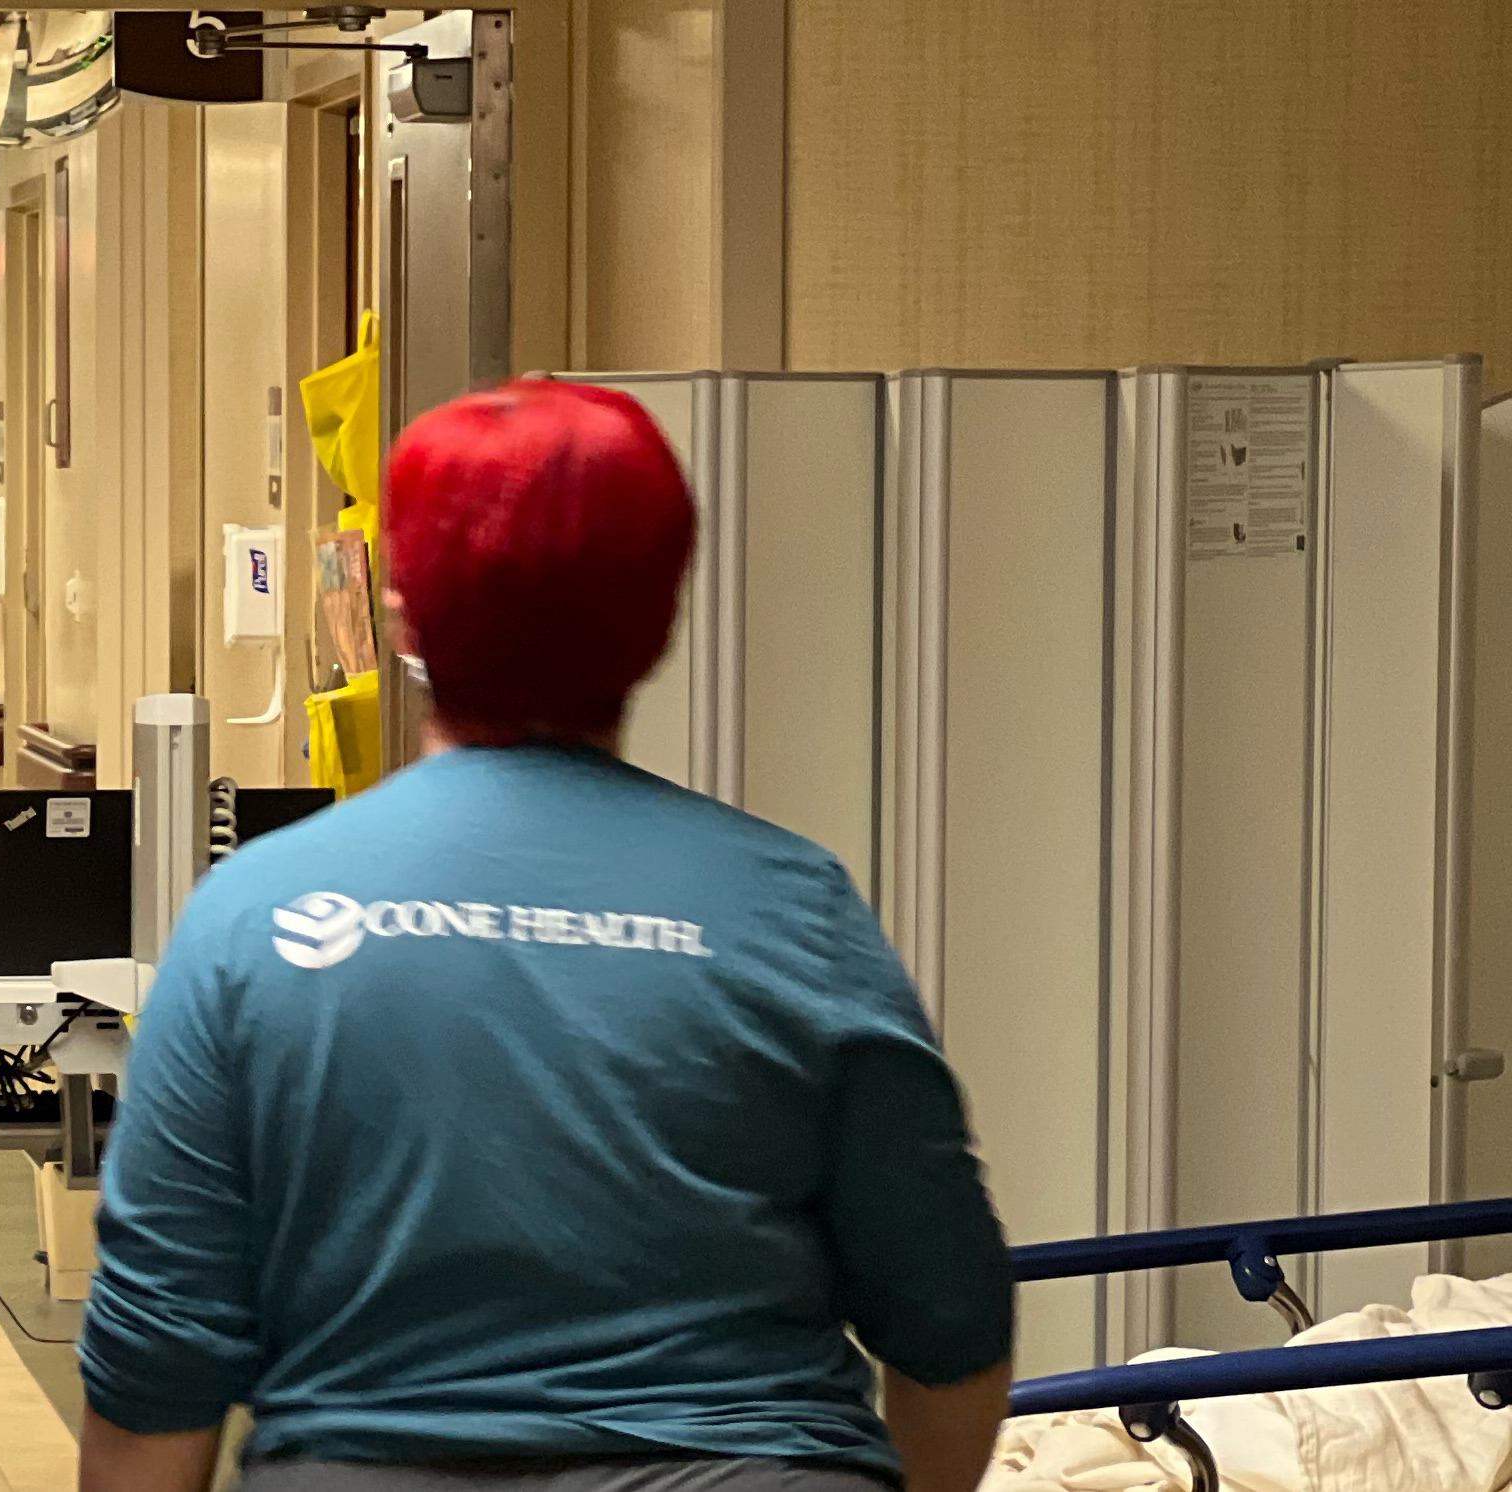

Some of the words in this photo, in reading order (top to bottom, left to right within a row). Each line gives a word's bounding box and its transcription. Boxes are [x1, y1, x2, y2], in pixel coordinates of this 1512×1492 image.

[186, 10, 226, 58] 5
[363, 900, 506, 939] CONE
[506, 904, 713, 957] HEALTH
